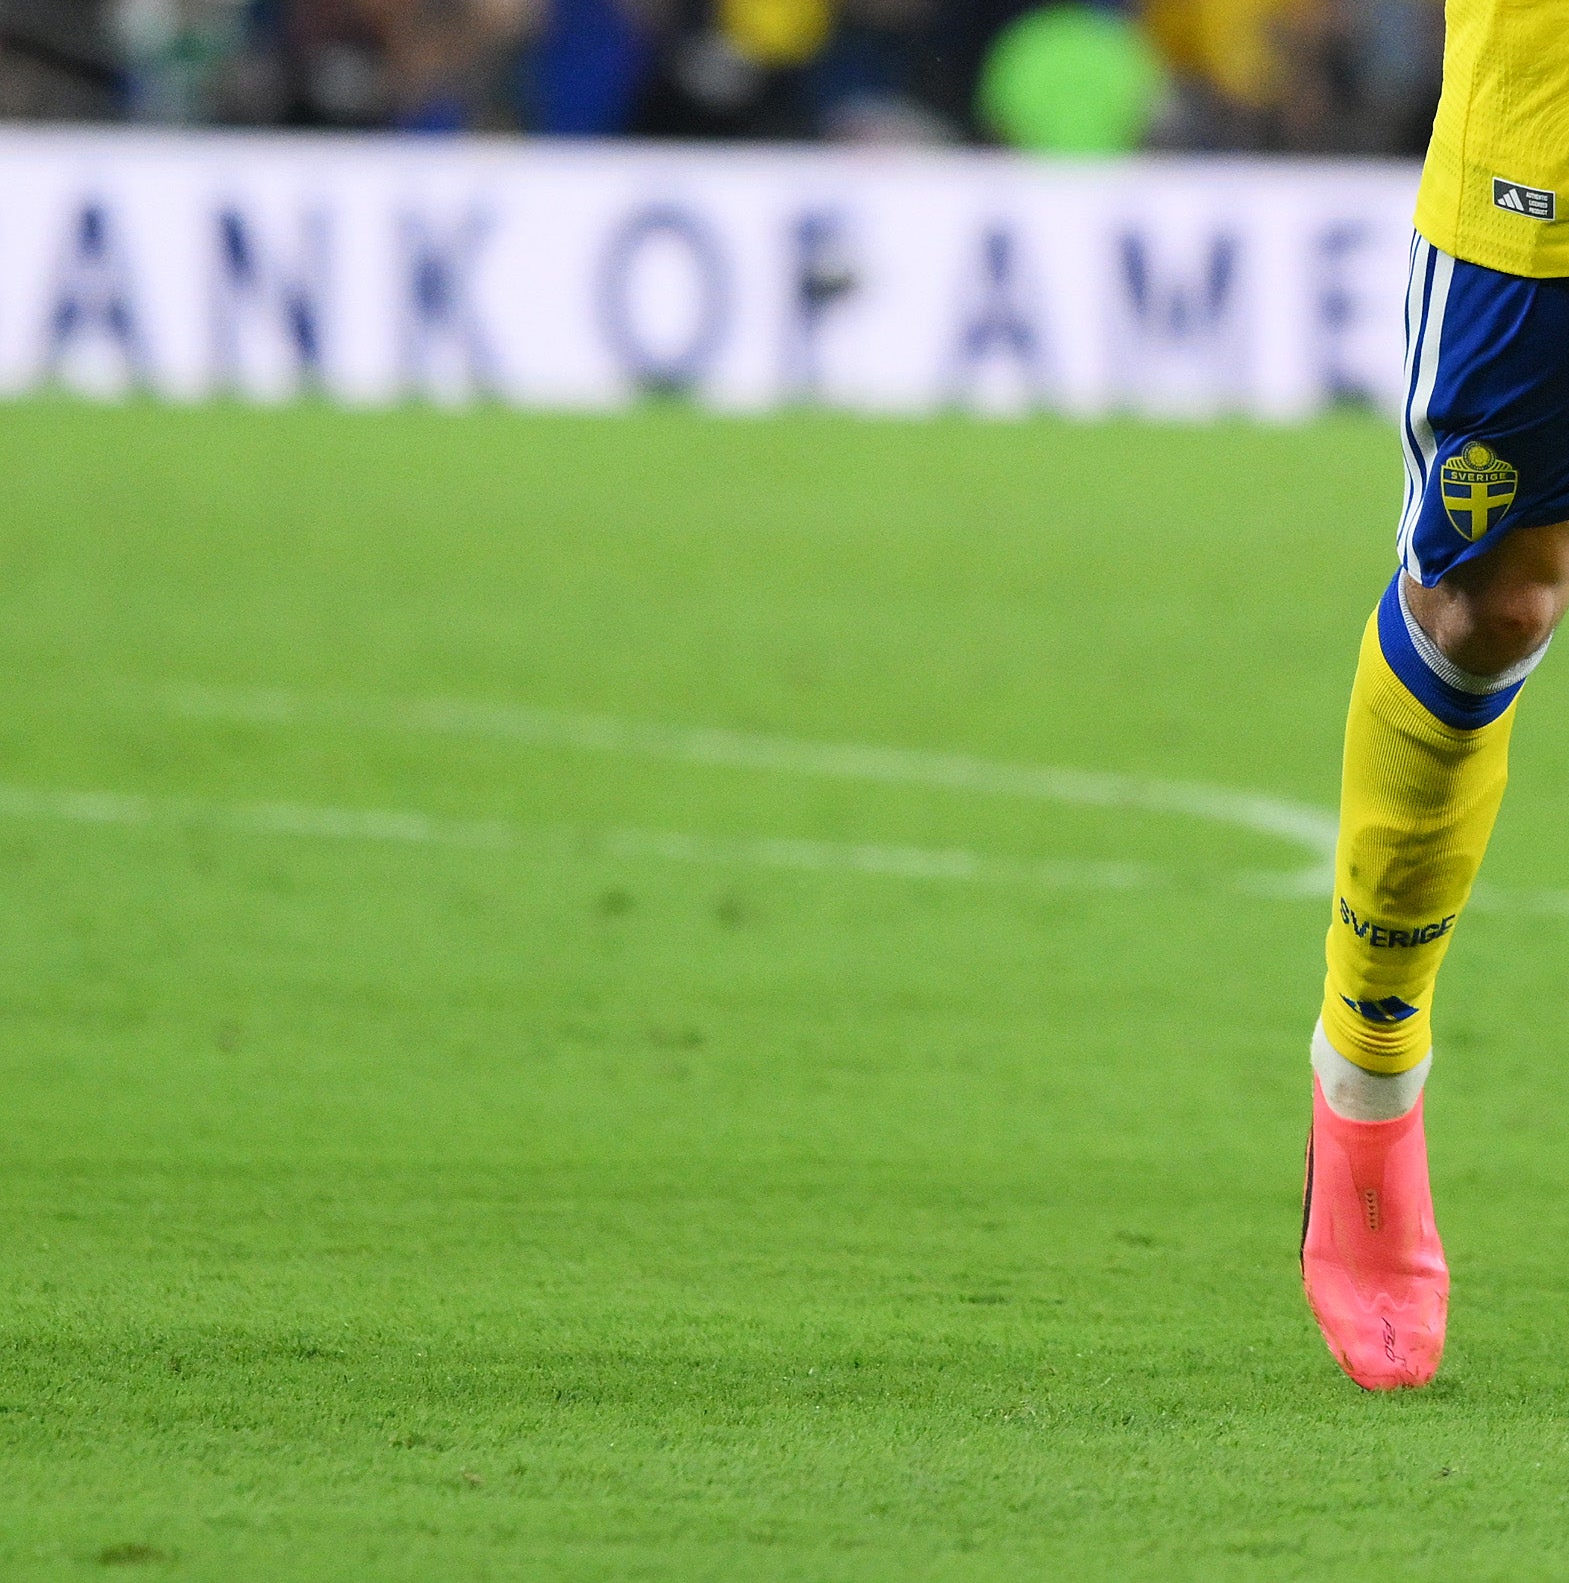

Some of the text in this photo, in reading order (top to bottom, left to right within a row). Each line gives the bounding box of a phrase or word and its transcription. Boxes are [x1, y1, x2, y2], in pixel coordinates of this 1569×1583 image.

[40, 202, 495, 402] ANK
[595, 212, 875, 407] OF
[1450, 471, 1507, 482] SVERIGE
[1340, 897, 1456, 948] SVERIGE
